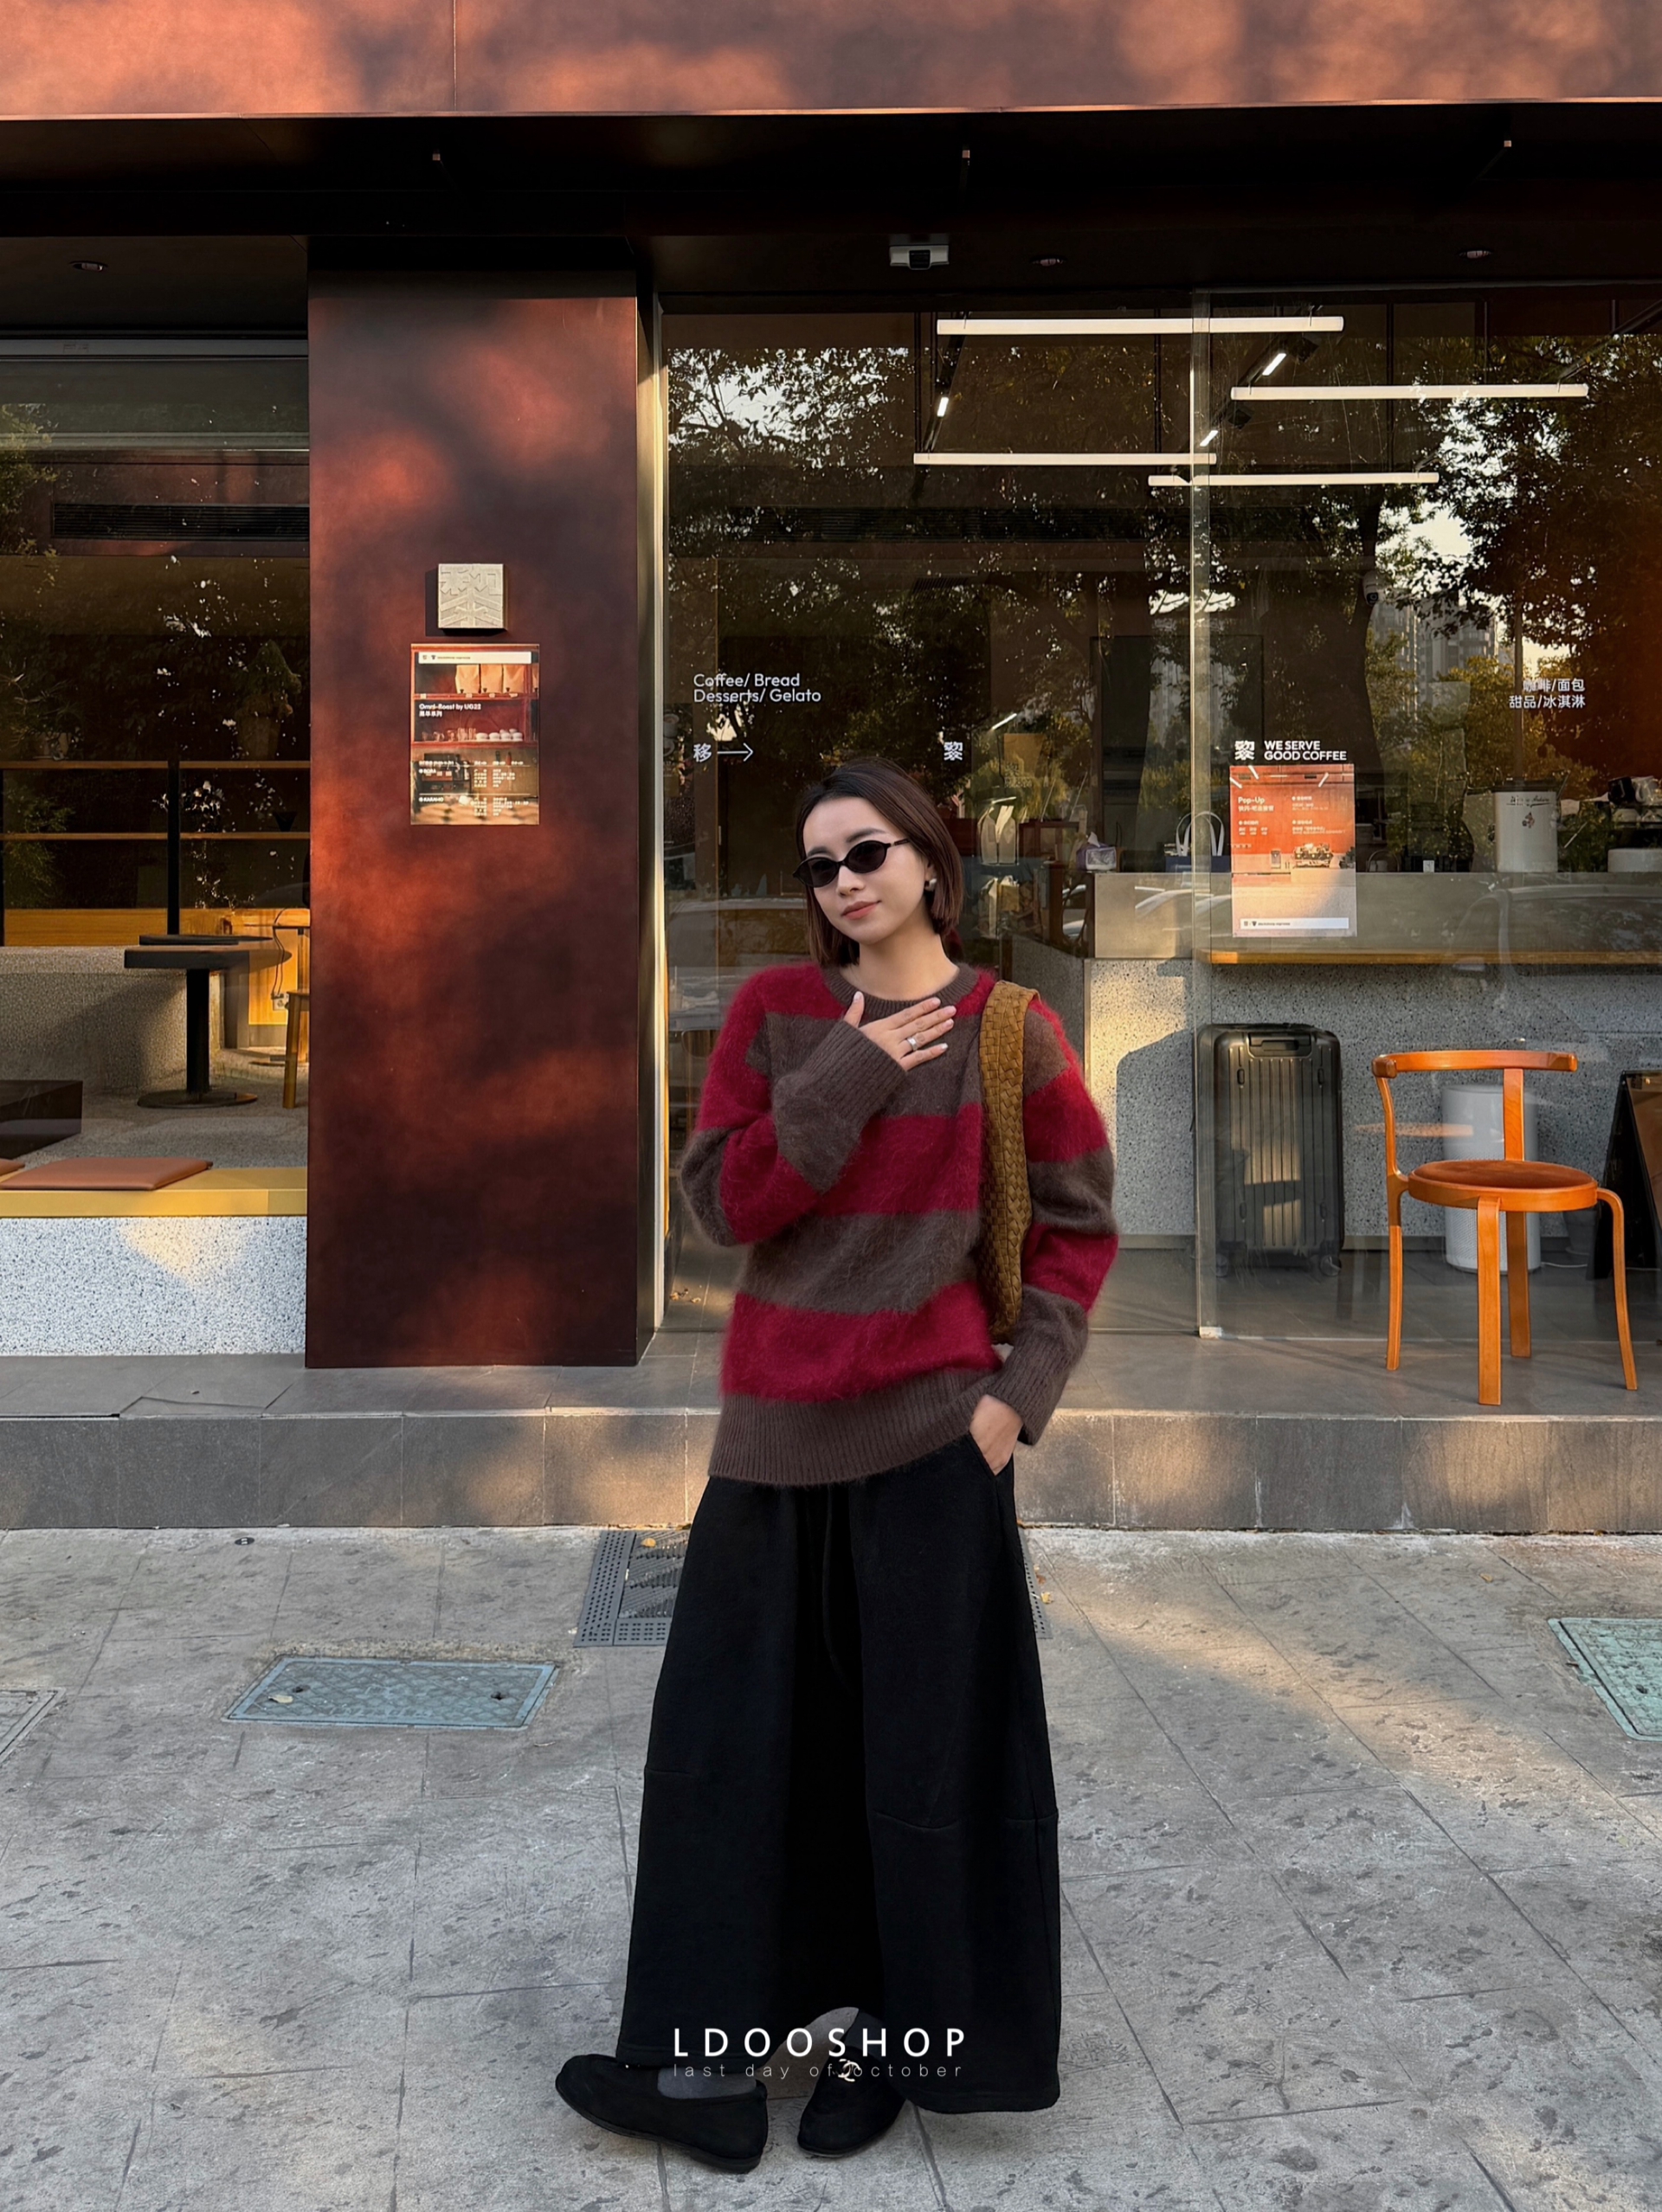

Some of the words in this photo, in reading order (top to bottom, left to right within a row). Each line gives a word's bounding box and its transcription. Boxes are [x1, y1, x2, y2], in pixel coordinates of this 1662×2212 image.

[693, 672, 750, 687] Coffee/
[754, 672, 800, 687] Bread
[693, 688, 766, 703] Desserts/
[770, 688, 821, 703] Gelato
[1509, 694, 1586, 709] 甜品/冰淇淋
[693, 743, 712, 762] 移
[1264, 740, 1283, 750] WE
[1285, 740, 1321, 750] SERVE
[1264, 750, 1301, 761] GOOD
[1302, 750, 1347, 761] COFFEE
[1238, 796, 1266, 805] Pop-Up
